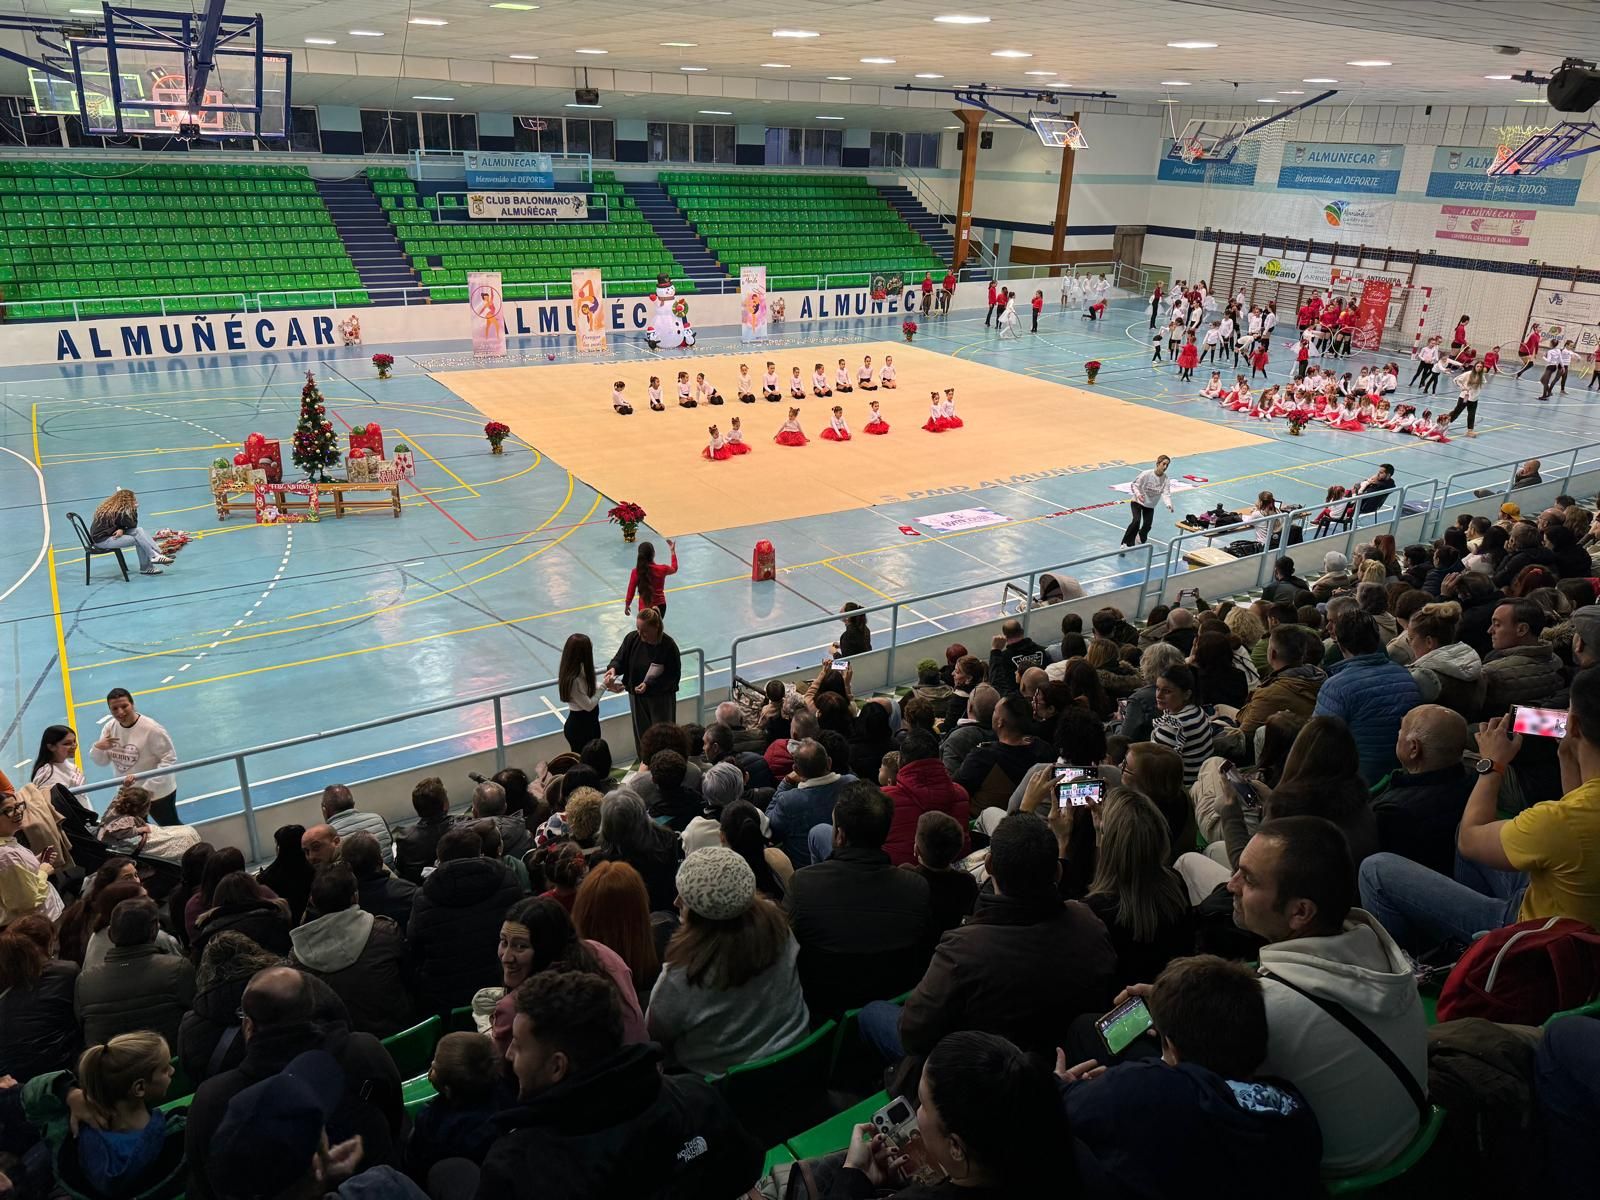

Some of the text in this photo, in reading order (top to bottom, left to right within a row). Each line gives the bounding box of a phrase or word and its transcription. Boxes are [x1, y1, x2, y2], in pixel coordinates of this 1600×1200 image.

[518, 176, 545, 184] DEPORTE
[1344, 175, 1380, 186] DEPORTE
[1454, 180, 1548, 195] DEPORTE para TODOS
[485, 196, 571, 206] CLUB BALONMANO
[501, 206, 558, 216] ALMUÑÉCAR
[1258, 265, 1296, 279] Manzano
[57, 314, 335, 360] ALMUÑÉCAR
[907, 485, 970, 500] PMD
